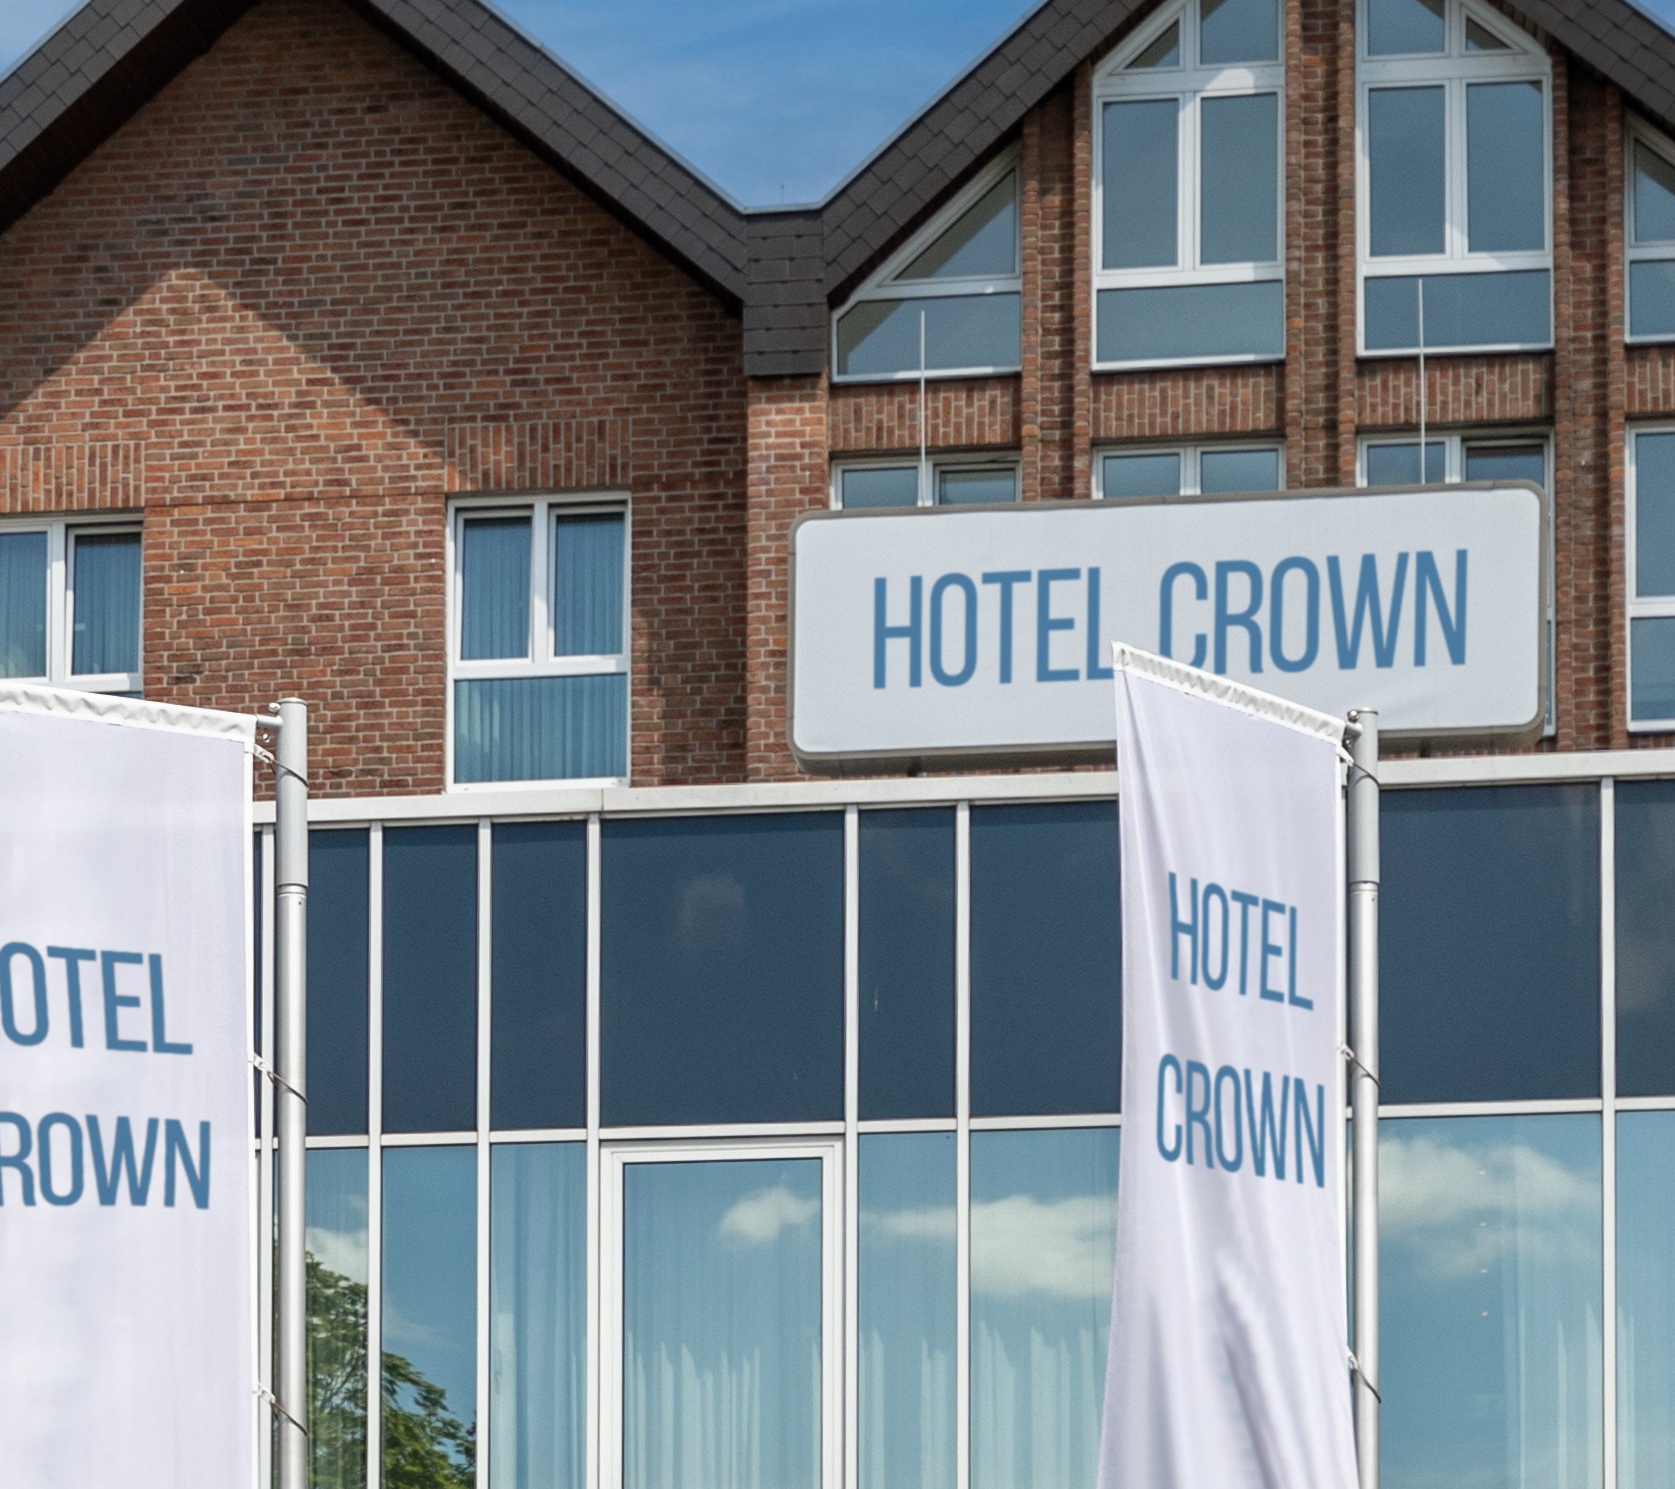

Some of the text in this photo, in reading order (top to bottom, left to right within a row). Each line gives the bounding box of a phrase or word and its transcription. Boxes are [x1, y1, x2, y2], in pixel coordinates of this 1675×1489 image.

[872, 548, 1469, 690] HOTEL CROWN
[1167, 871, 1314, 1011] HOTEL
[1156, 1052, 1325, 1188] CROWN
